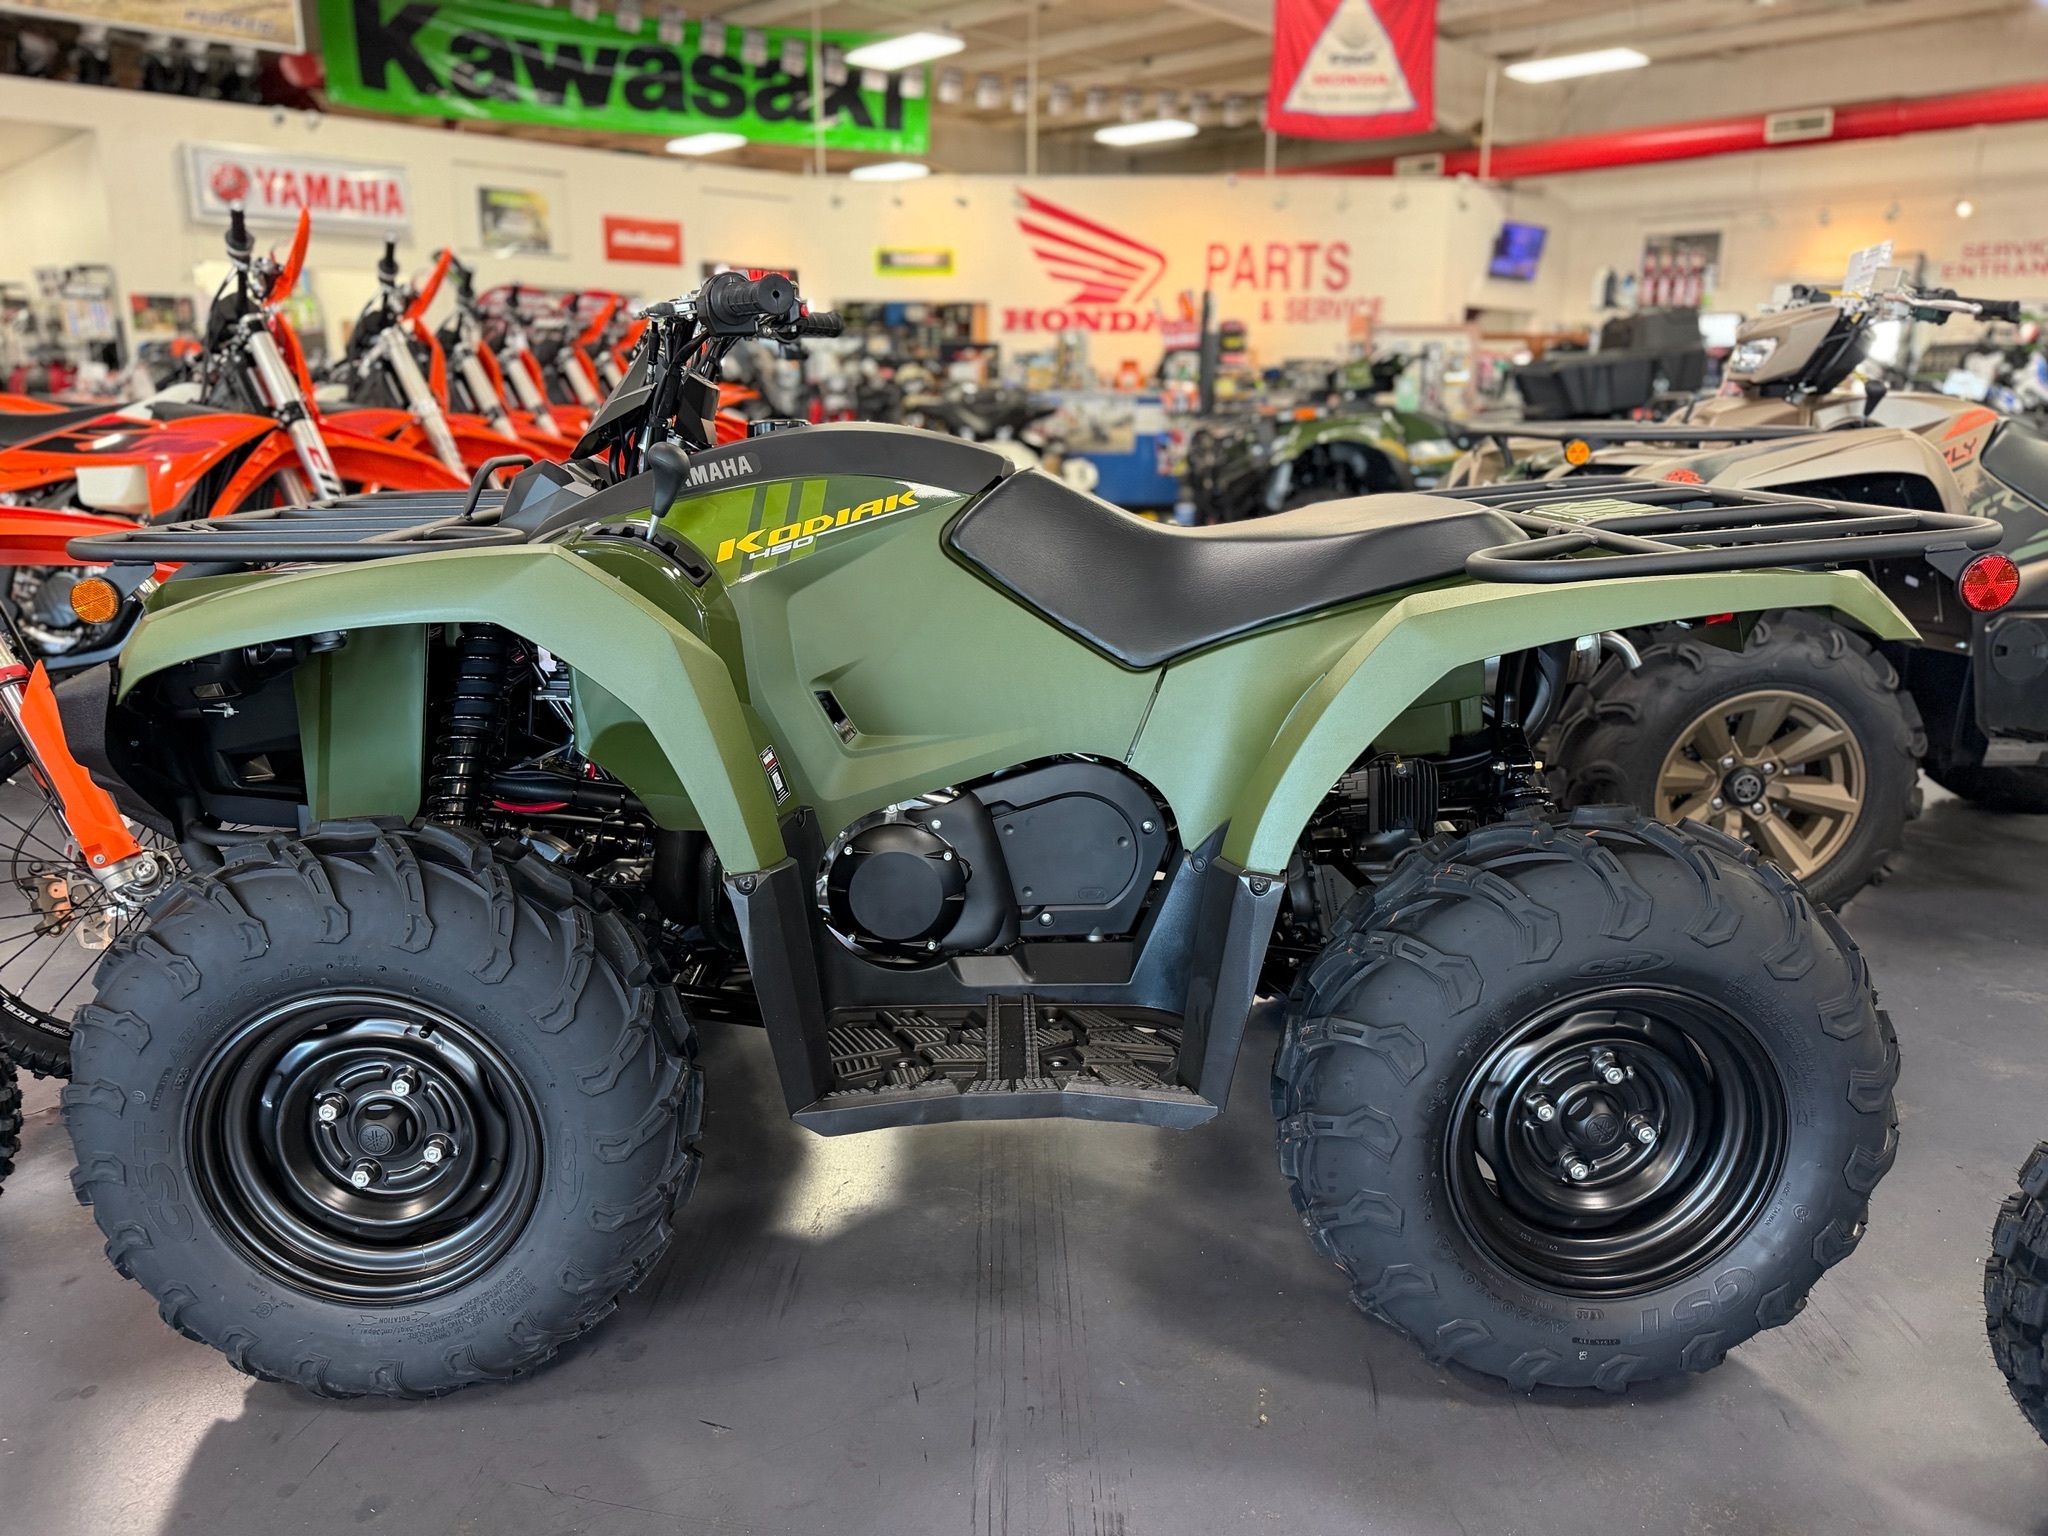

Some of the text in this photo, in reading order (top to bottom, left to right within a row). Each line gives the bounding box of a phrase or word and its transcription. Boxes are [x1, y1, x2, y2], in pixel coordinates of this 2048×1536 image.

[353, 0, 904, 131] Kawasaki
[256, 167, 404, 215] YAMAHA
[1206, 241, 1352, 291] PARTS
[1260, 297, 1382, 324] & SERVICE
[685, 455, 753, 488] MAHA
[716, 490, 920, 563] KODIAK
[749, 535, 816, 560] 450
[1578, 954, 1652, 977] CST
[407, 970, 454, 995] NYLON
[2, 999, 39, 1025] EXCEL
[133, 1120, 194, 1242] CST
[504, 1275, 528, 1296] MANUAL
[464, 1296, 480, 1308] BEAD
[490, 1295, 504, 1307] FOR
[491, 1293, 521, 1315] VEHICLE
[507, 1285, 538, 1314] WARNING
[1640, 1266, 1756, 1339] CST
[379, 1315, 411, 1324] ROTATION
[447, 1306, 488, 1329] OPERATING
[468, 1312, 490, 1328] LABEL
[417, 1331, 451, 1345] OWNER'S
[453, 1326, 465, 1335] OR
